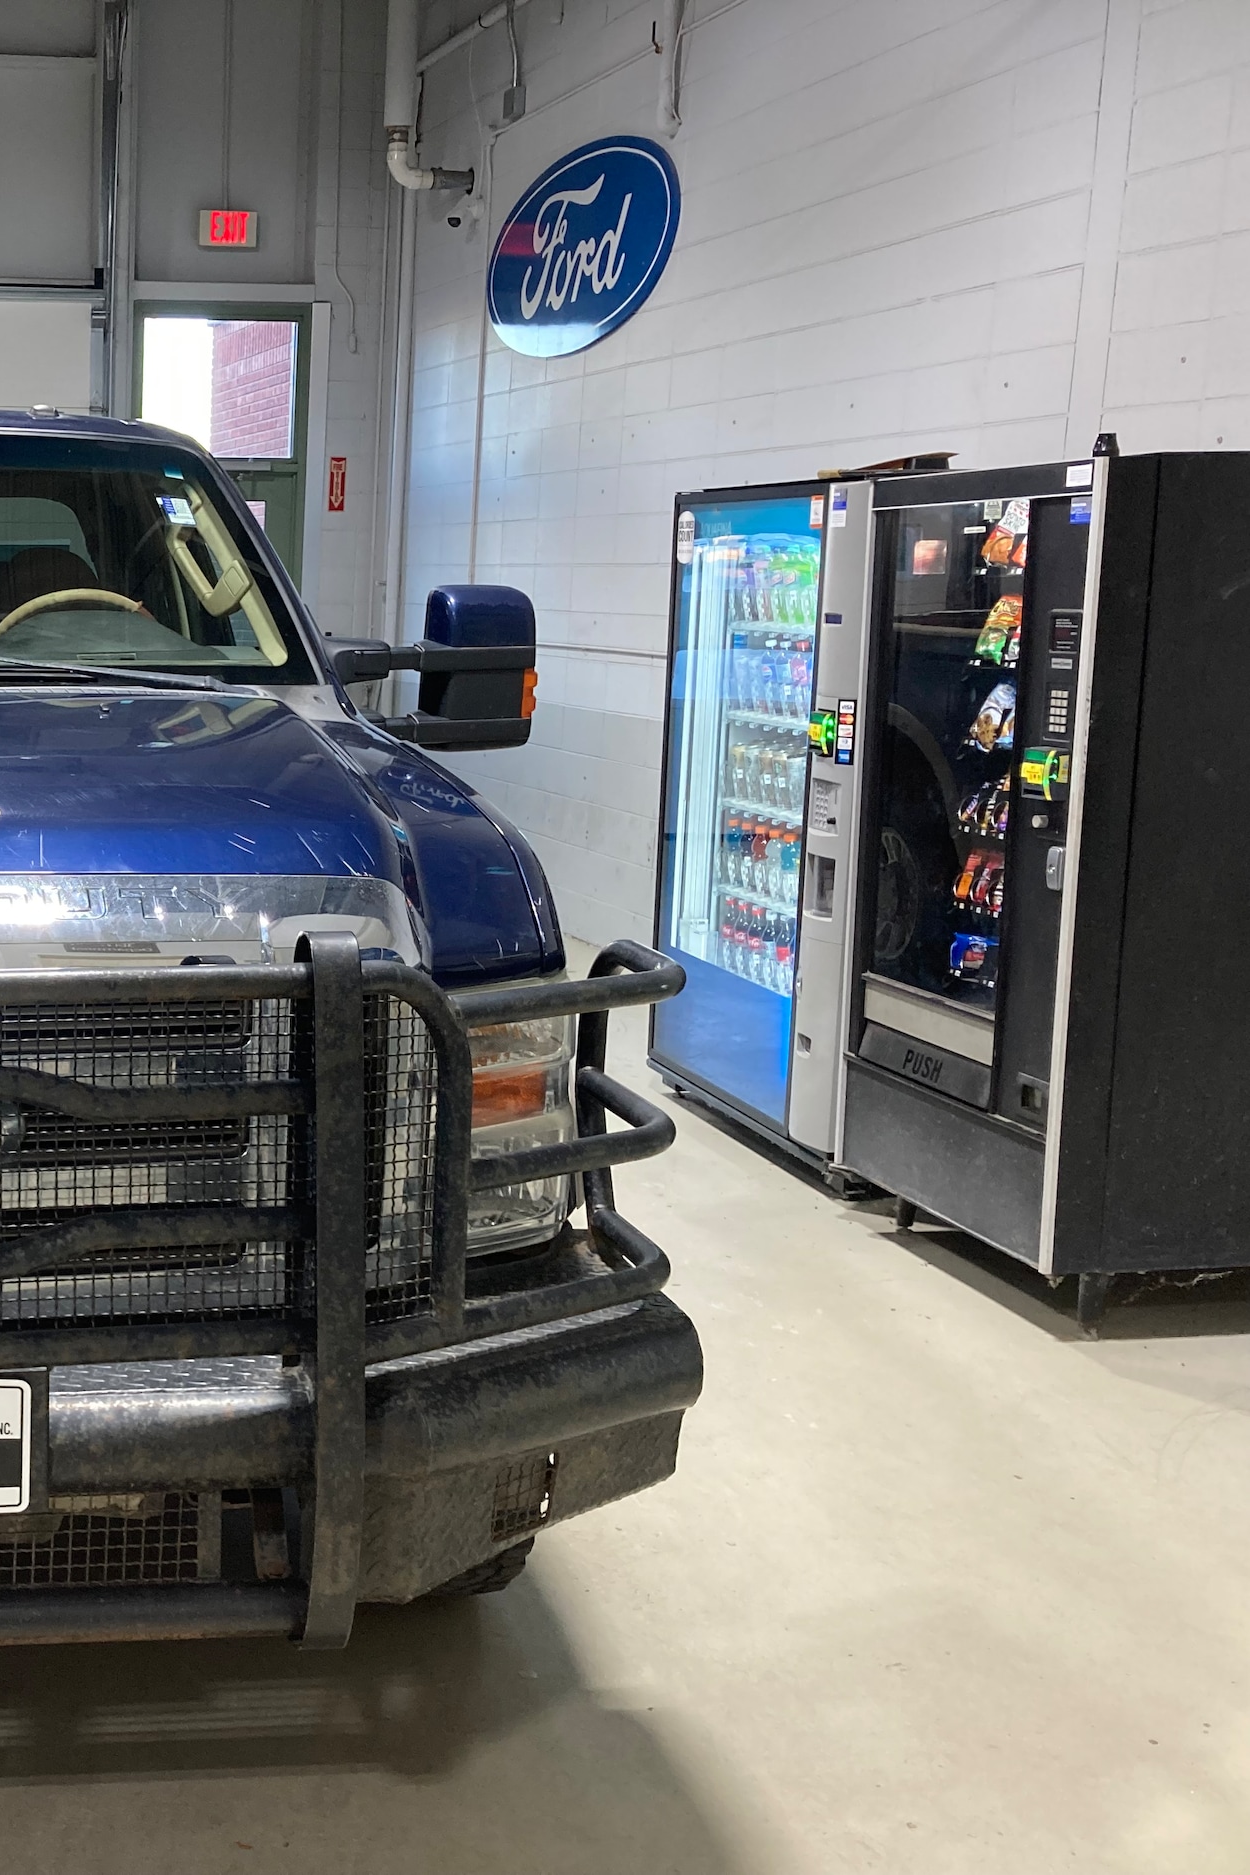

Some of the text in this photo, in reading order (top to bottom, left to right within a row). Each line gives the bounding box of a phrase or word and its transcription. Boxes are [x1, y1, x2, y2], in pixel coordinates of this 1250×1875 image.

[209, 209, 250, 243] EXIT
[520, 172, 633, 320] Ford
[678, 530, 694, 542] COUNT
[902, 1048, 943, 1083] PUSH
